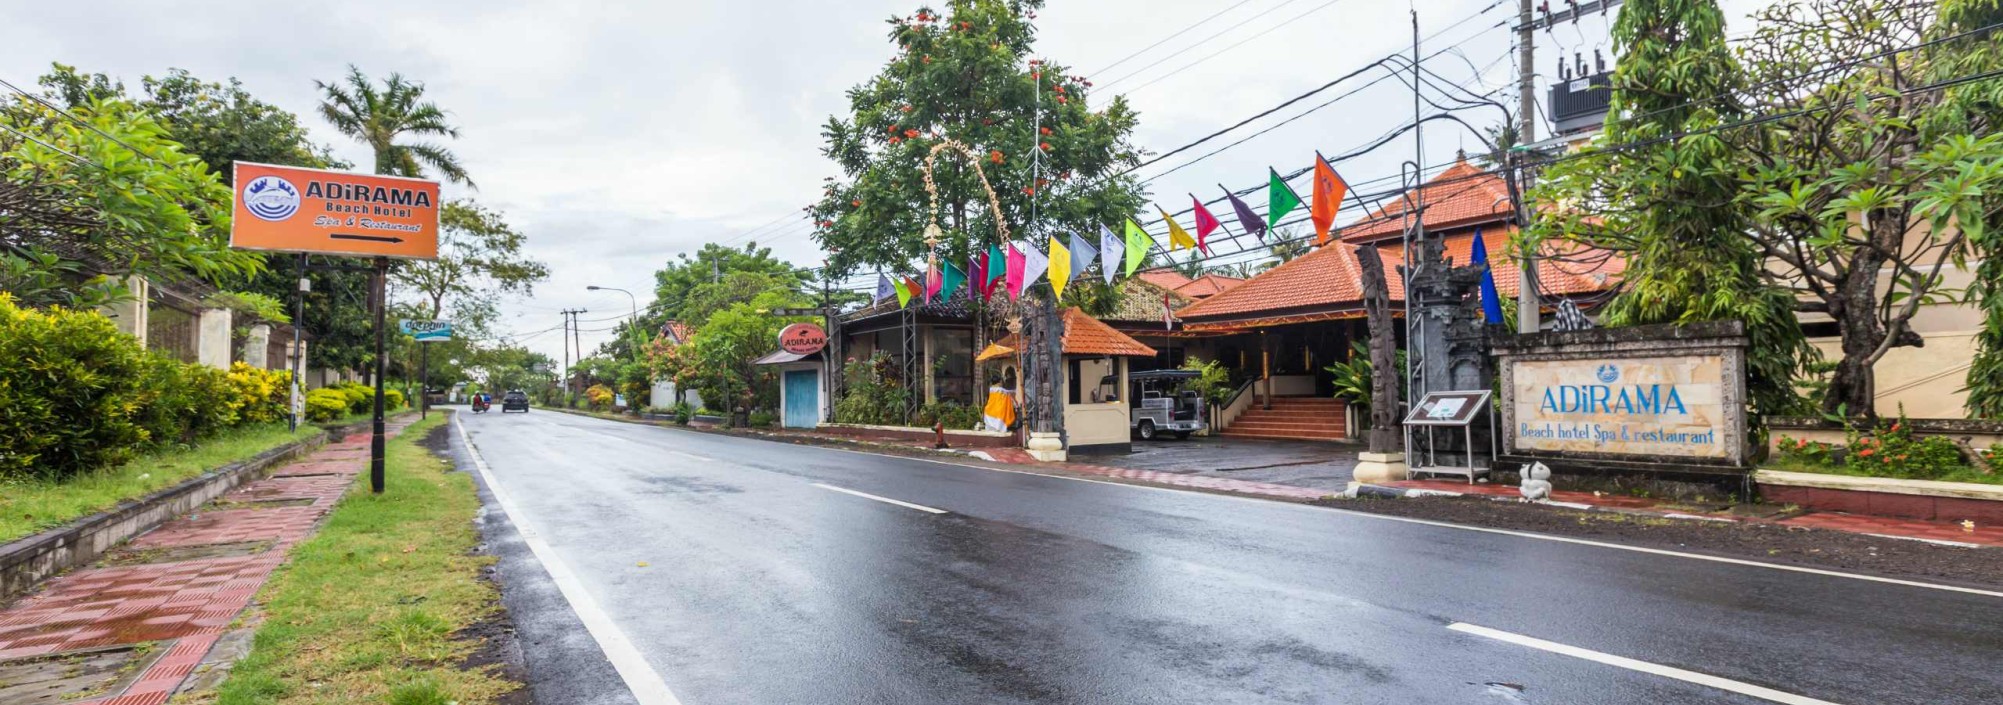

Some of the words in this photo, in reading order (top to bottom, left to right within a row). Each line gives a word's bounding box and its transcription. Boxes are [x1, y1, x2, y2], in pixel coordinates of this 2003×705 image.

[305, 181, 431, 207] ADiRAMA
[326, 202, 369, 215] Beach
[374, 204, 412, 218] Hotel
[315, 215, 340, 228] Spa
[346, 216, 354, 226] &
[360, 217, 421, 232] Restaurant
[1540, 384, 1688, 415] ADiRAMA
[1521, 423, 1554, 438] Beach
[1558, 424, 1590, 440] hotel
[1594, 424, 1617, 444] Spa
[1621, 425, 1630, 441] &
[1634, 427, 1715, 445] restaurant
